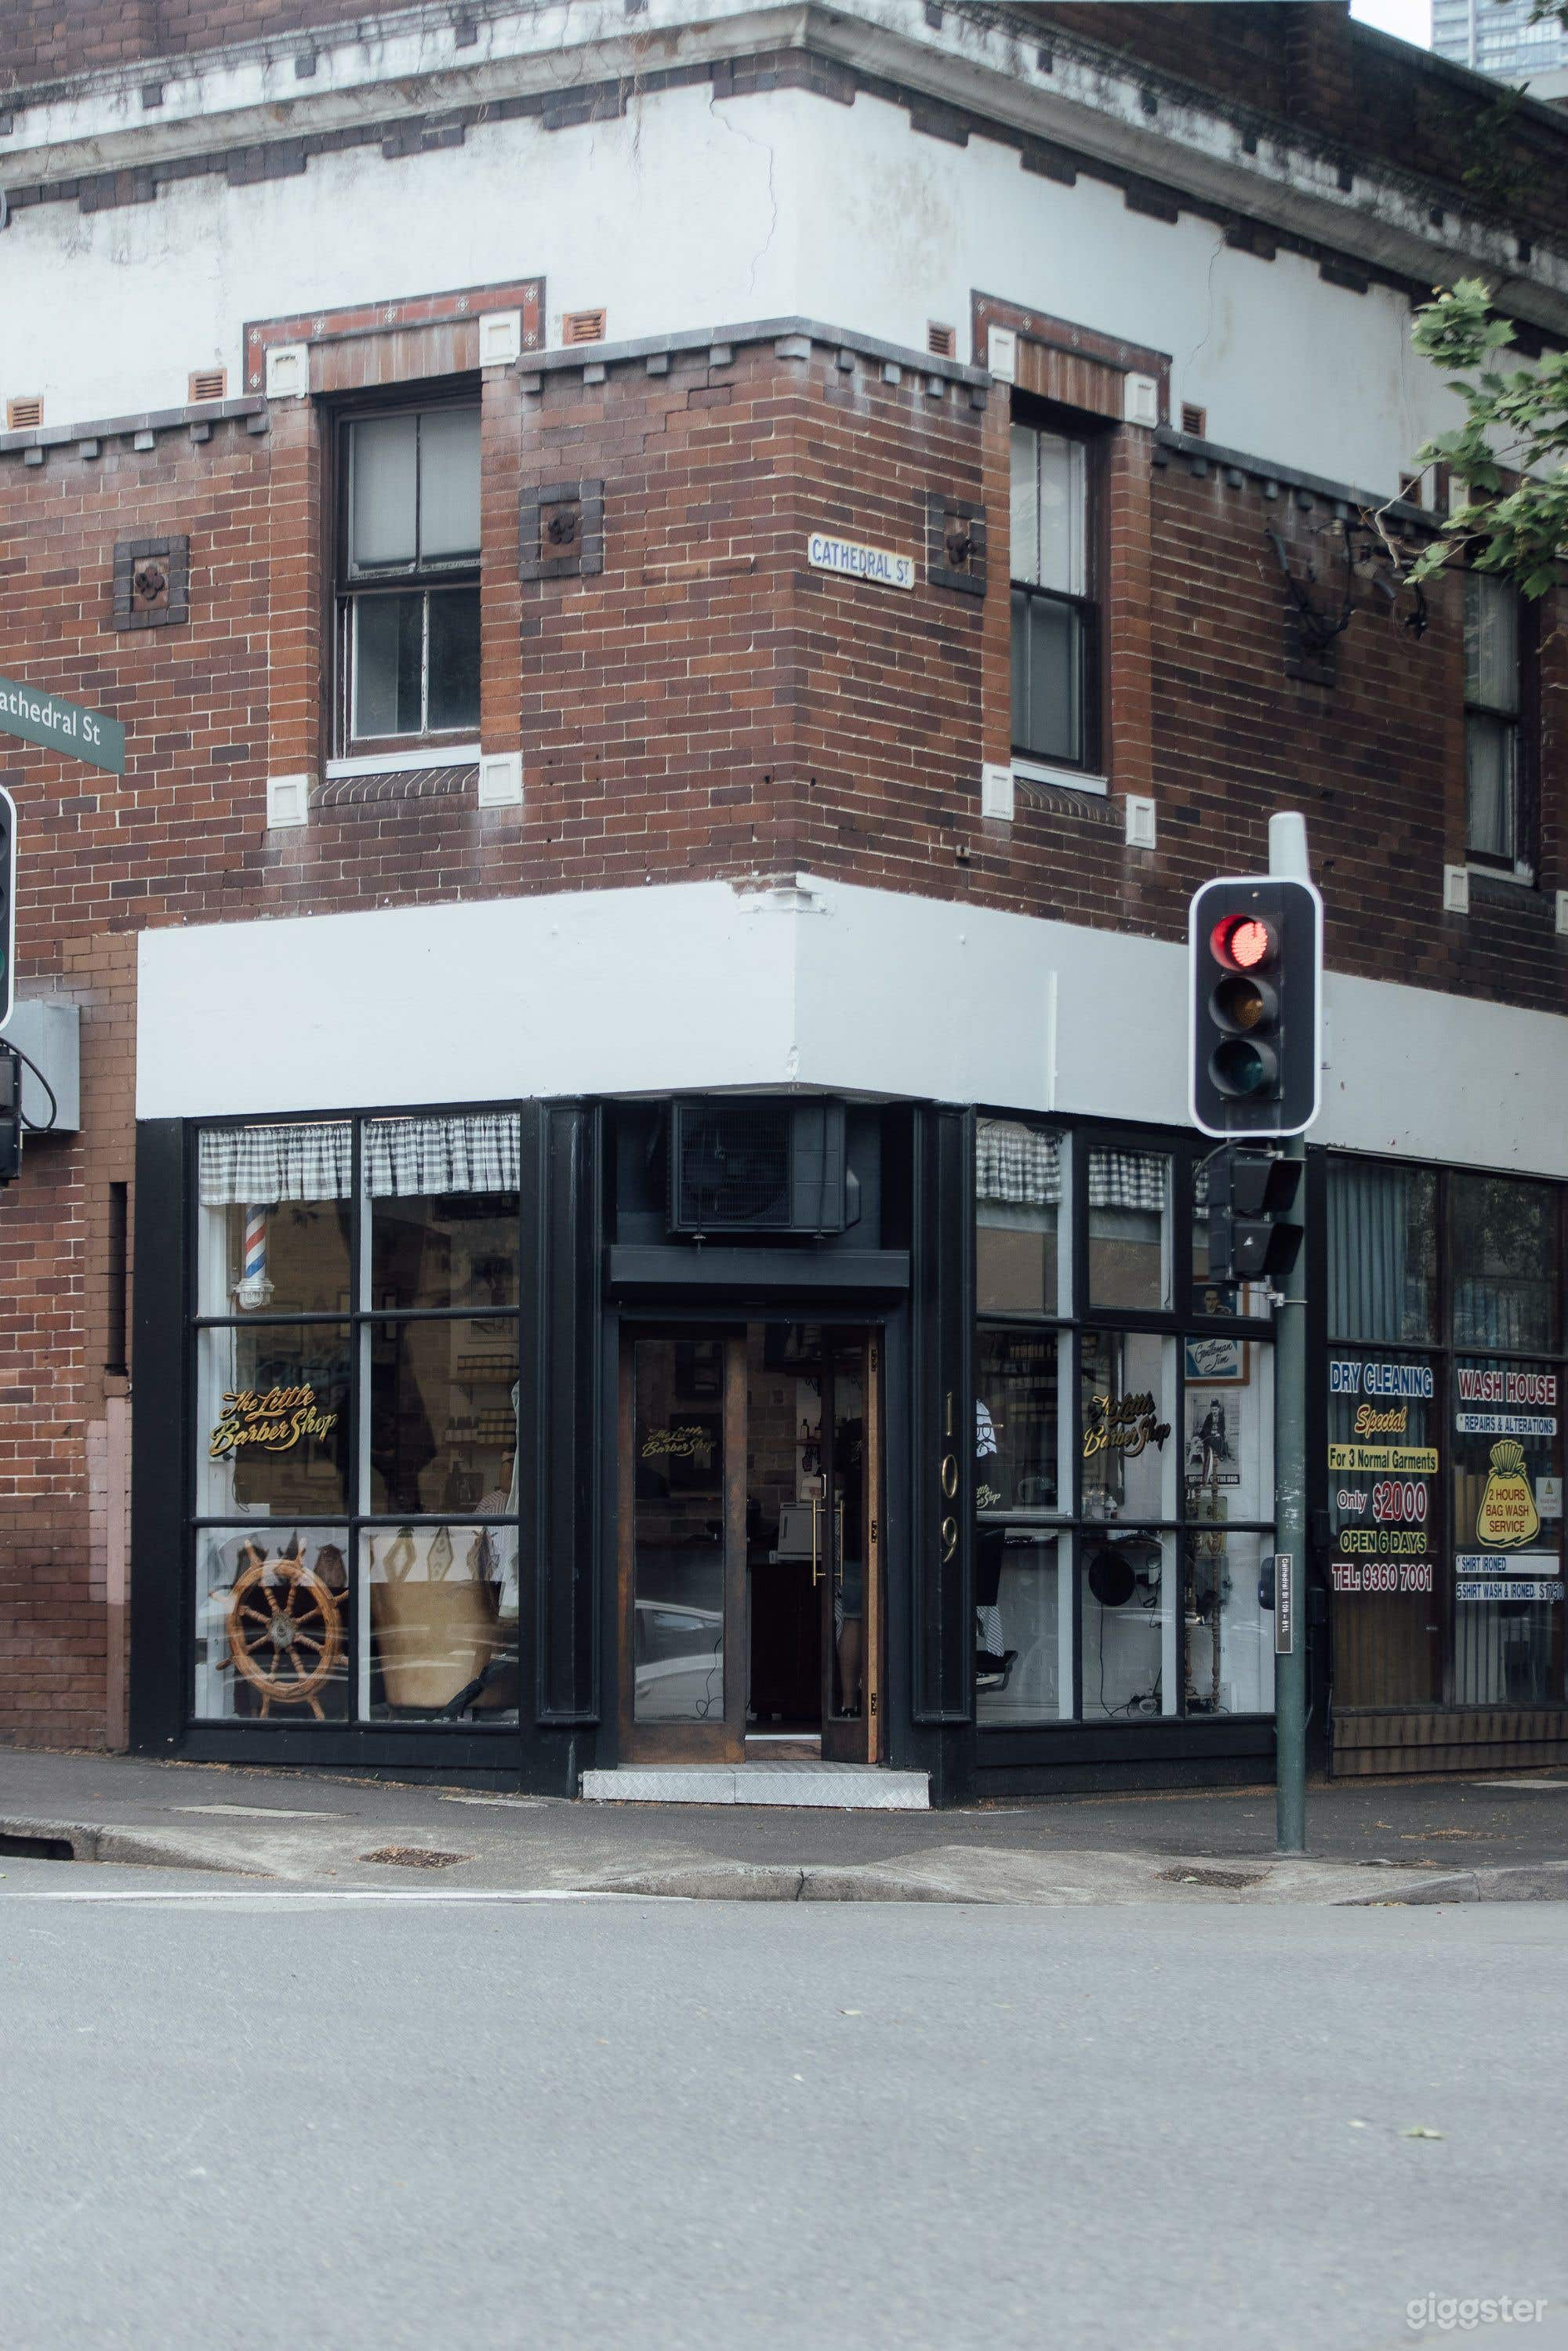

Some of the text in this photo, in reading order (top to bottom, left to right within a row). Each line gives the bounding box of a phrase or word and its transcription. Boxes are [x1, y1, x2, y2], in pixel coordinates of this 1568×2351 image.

[812, 539, 891, 579] CATHEDRAL
[0, 691, 101, 746] athedral St
[1195, 1339, 1233, 1364] Gentleman
[1204, 1354, 1229, 1373] Jim
[1330, 1361, 1433, 1398] DRY CLEANING
[1457, 1368, 1556, 1406] WASH HOUSE
[220, 1382, 316, 1422] The Little
[209, 1406, 339, 1457] Barber Shop
[1355, 1404, 1408, 1439] Special
[1465, 1416, 1554, 1435] REPAIRS & ALTERATIONS
[641, 1441, 689, 1457] Barber
[1330, 1447, 1436, 1471] For 3 Normal Garments
[1337, 1480, 1427, 1522] Only $2000
[1489, 1489, 1526, 1501] 2 HOURS
[1486, 1504, 1504, 1516] BAG
[1505, 1505, 1529, 1517] WASH
[1489, 1520, 1525, 1533] SERVICE
[1339, 1529, 1428, 1555] OPEN 6 DAYS
[1462, 1557, 1507, 1572] SHIRT IRONED
[1332, 1563, 1432, 1592] TEL: 9360 7001
[1456, 1584, 1462, 1599] 5
[1462, 1584, 1481, 1598] SHIRT
[1483, 1584, 1502, 1598] WASH
[1504, 1584, 1509, 1598] &
